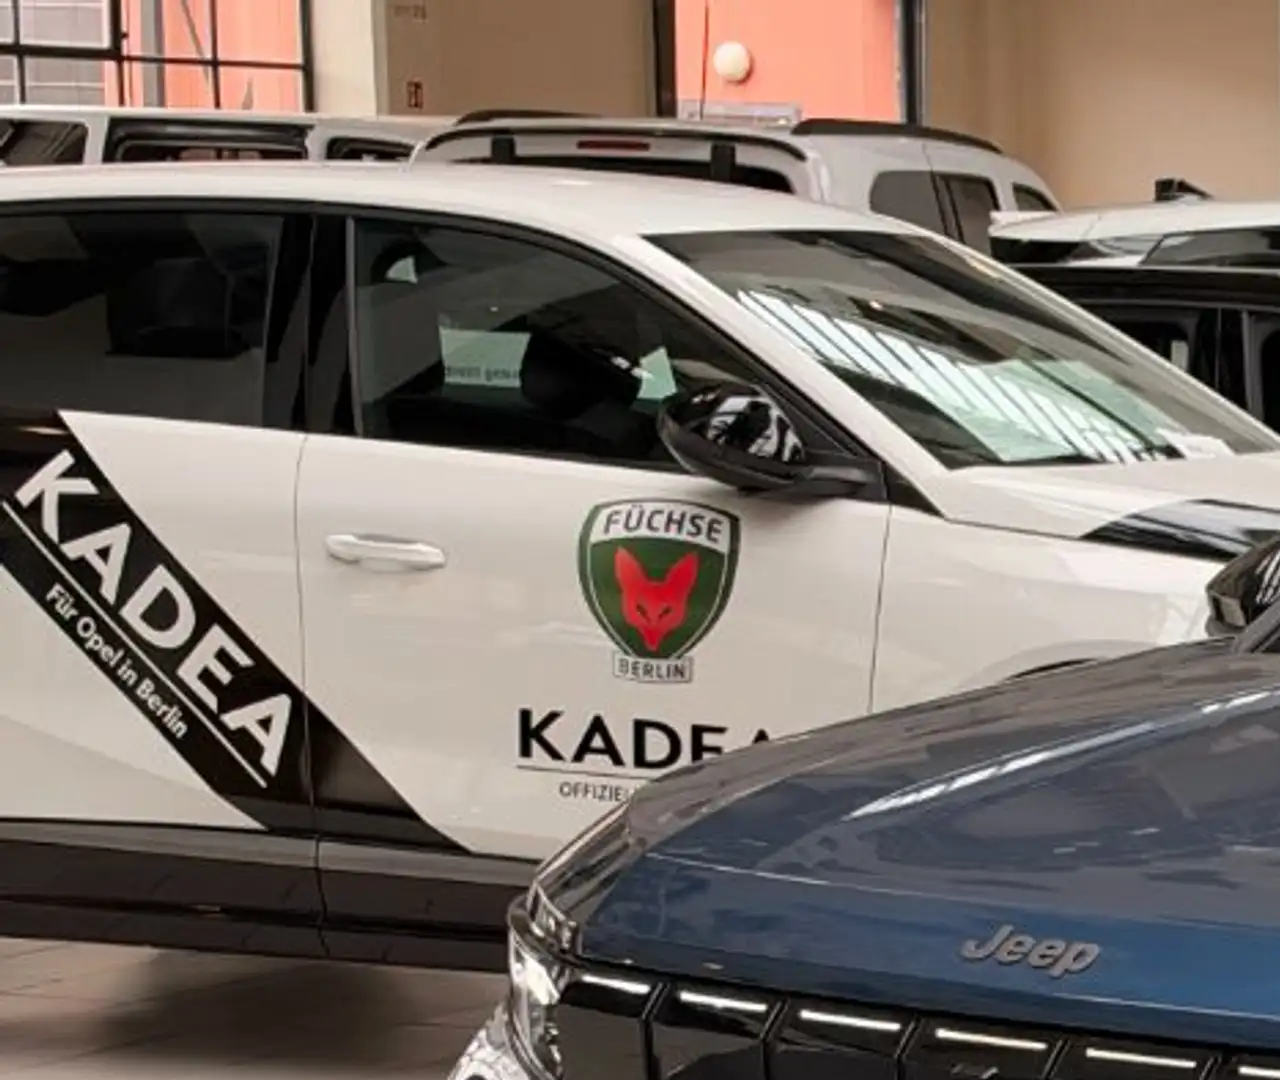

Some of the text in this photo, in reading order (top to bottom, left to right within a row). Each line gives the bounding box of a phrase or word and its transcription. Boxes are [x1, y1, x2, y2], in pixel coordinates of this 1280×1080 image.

[603, 504, 724, 544] FÜCHSE
[15, 449, 292, 776] KADEA
[46, 583, 189, 740] Für Opel in Berlin
[617, 658, 686, 679] BERLIN
[518, 708, 770, 768] KADE
[961, 924, 1101, 979] Jeep
